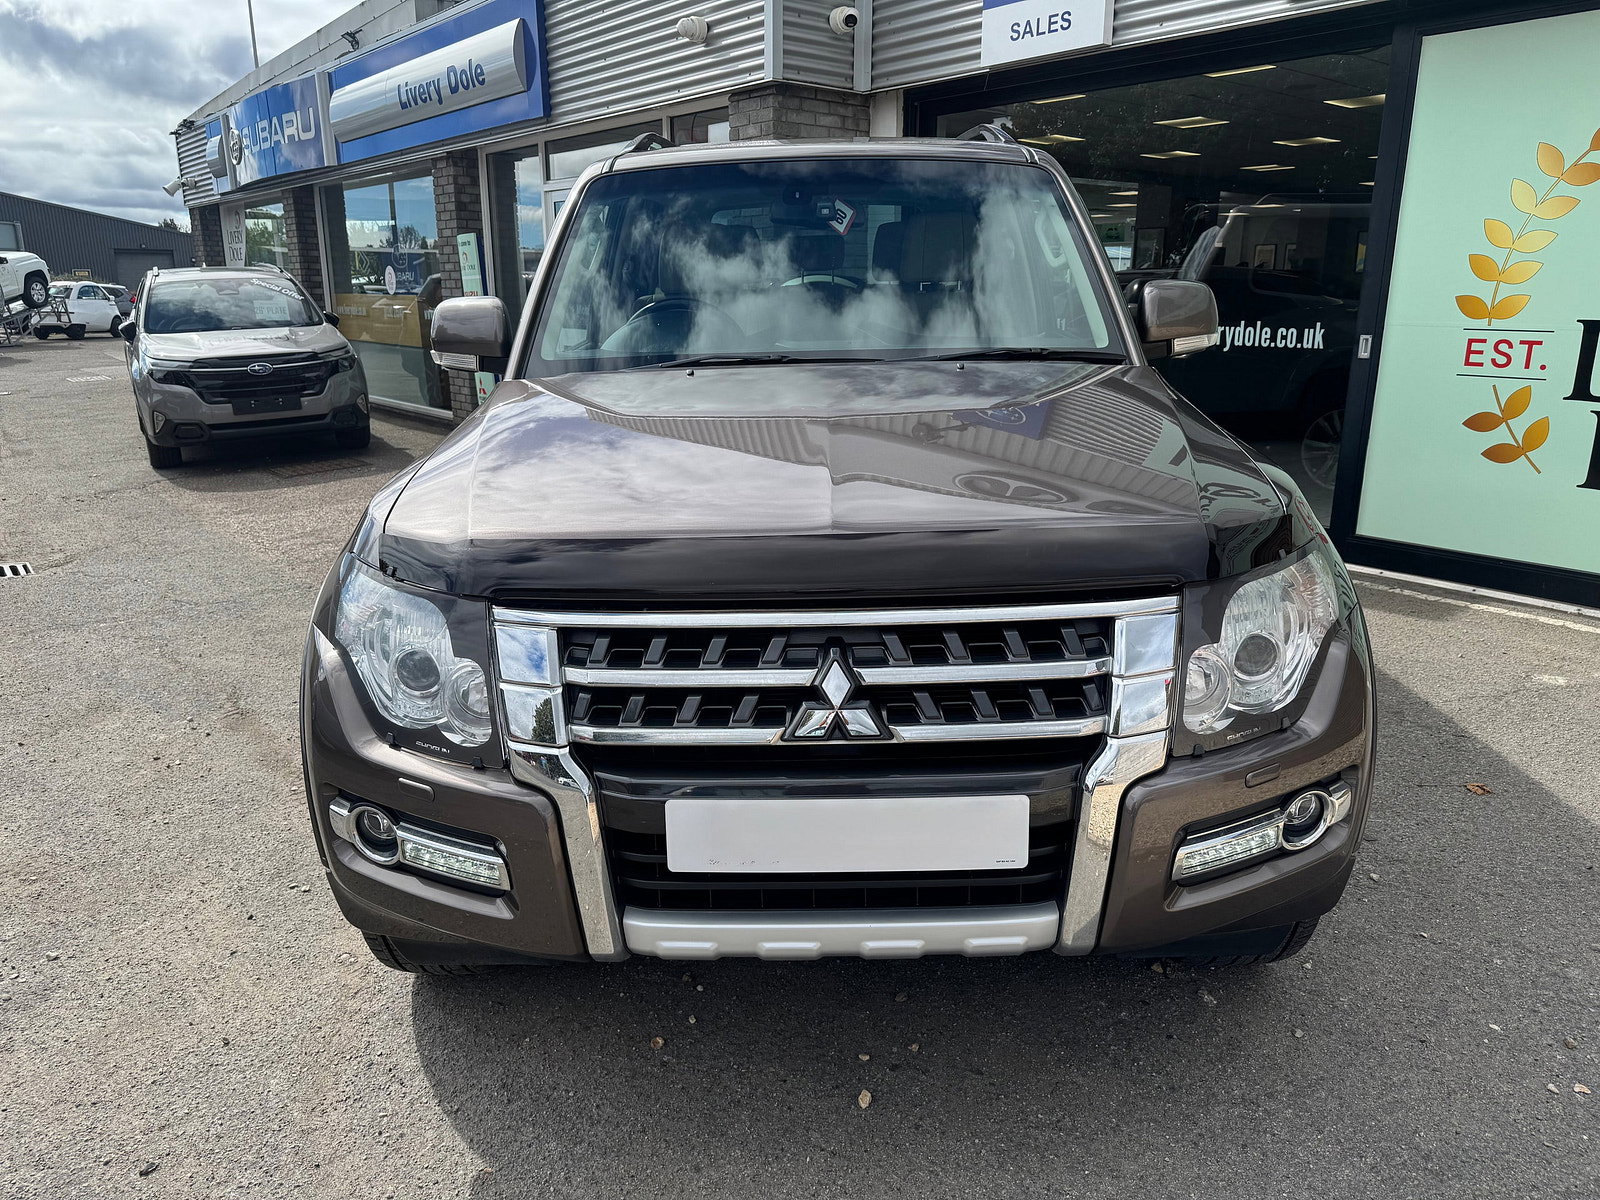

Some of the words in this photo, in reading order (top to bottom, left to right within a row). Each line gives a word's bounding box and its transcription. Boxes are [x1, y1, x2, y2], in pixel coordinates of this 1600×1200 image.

[1009, 10, 1072, 42] SALES
[397, 81, 443, 110] Livery
[446, 58, 486, 95] Dole
[241, 107, 316, 154] SUBARU
[250, 278, 282, 292] Special
[281, 288, 305, 300] Offer
[266, 306, 288, 315] PLATE
[1216, 321, 1325, 352] rydole.co.uk
[1463, 338, 1547, 371] EST.
